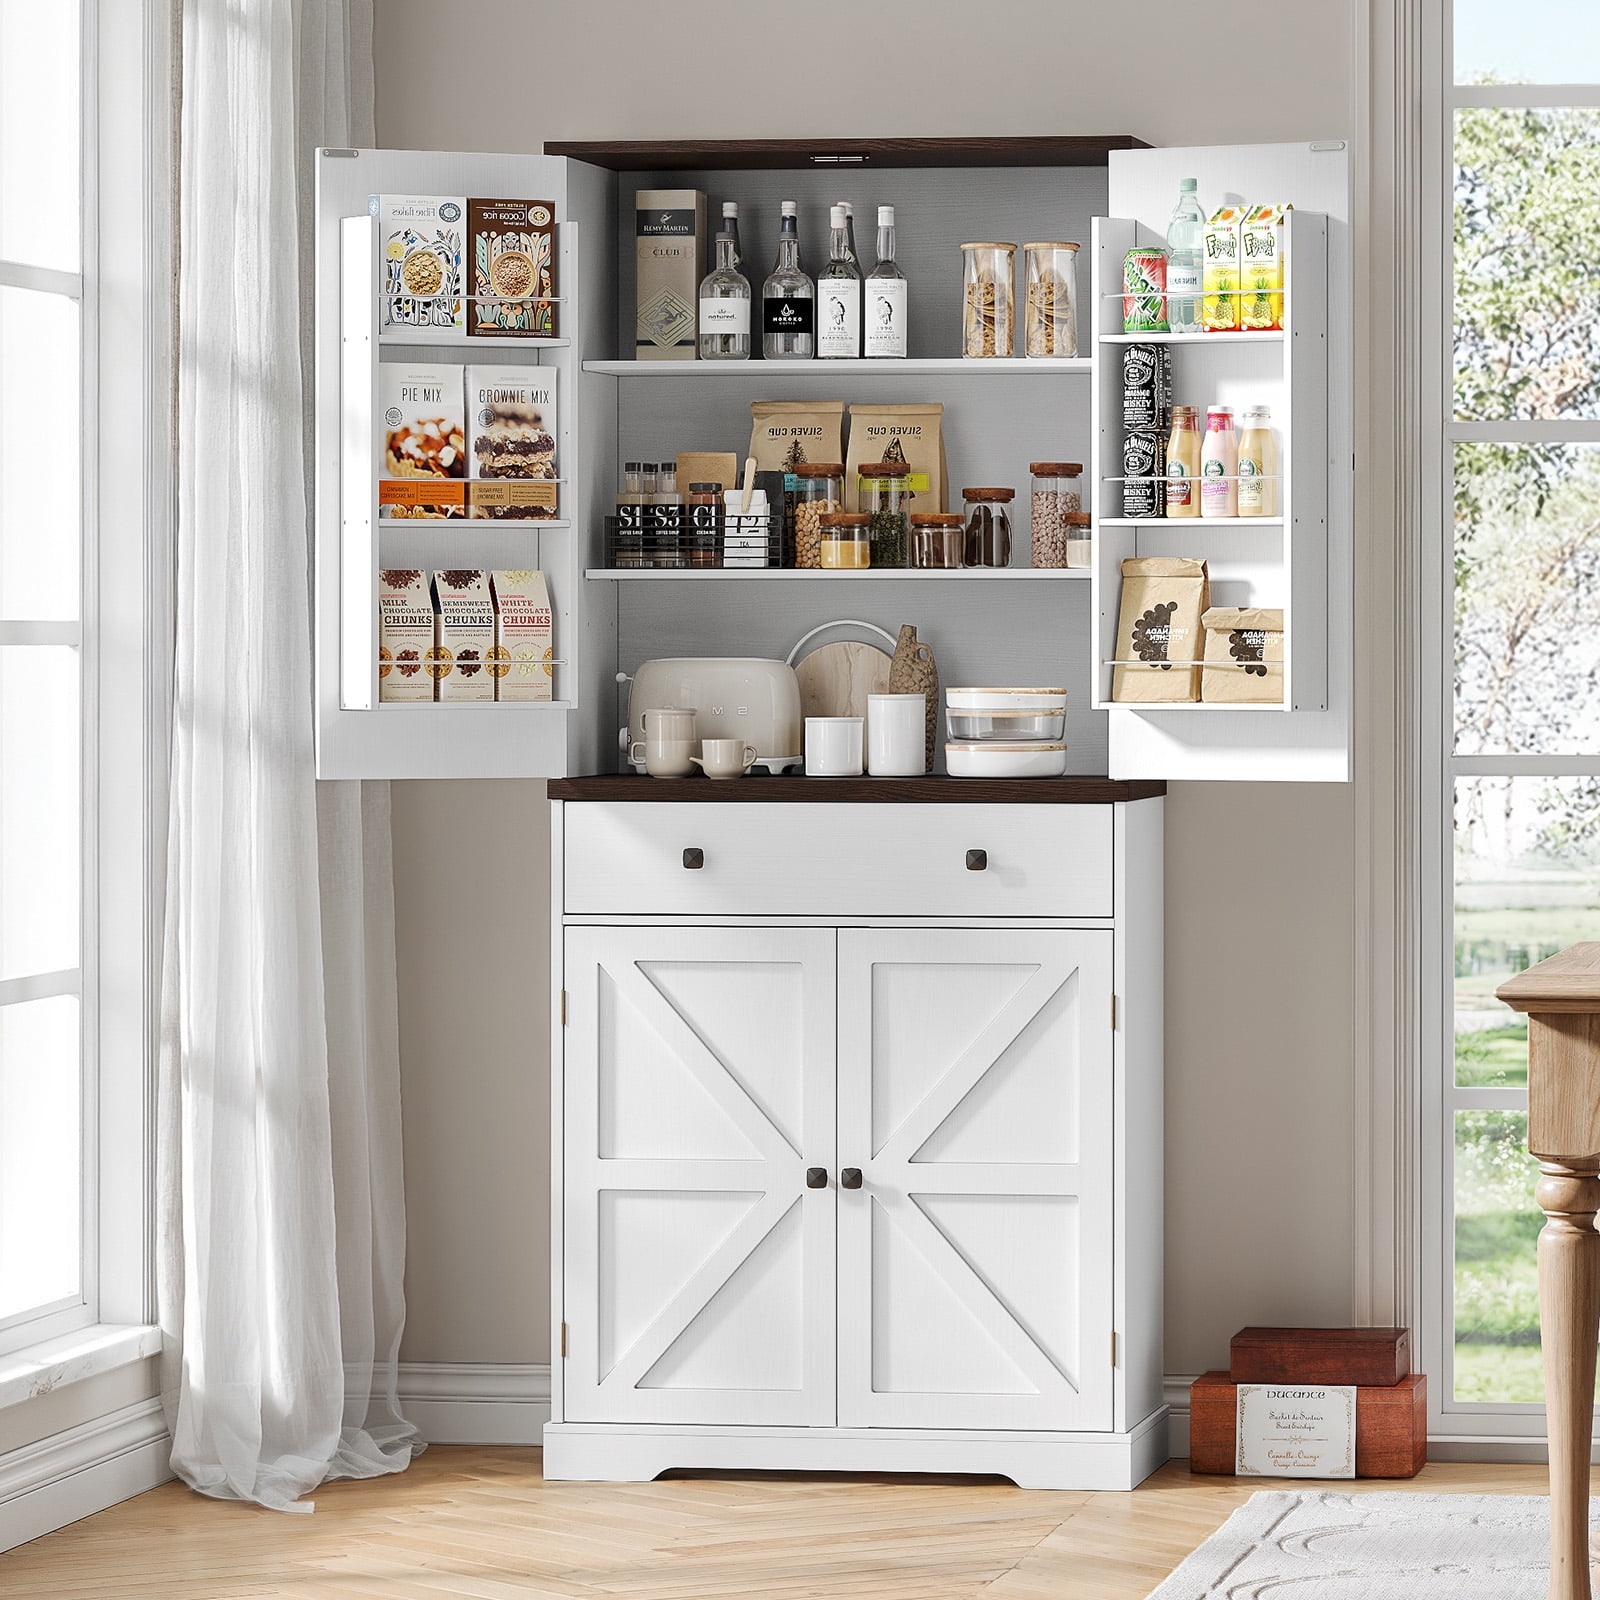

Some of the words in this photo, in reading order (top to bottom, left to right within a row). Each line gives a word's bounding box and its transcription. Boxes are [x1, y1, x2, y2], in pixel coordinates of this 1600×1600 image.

[653, 248, 680, 256] CLUB
[402, 388, 418, 402] PIE
[424, 388, 442, 402] MIX
[479, 389, 525, 403] BROWNIE
[532, 390, 549, 403] MIX
[619, 506, 640, 527] S1
[655, 506, 680, 527] S3
[693, 506, 716, 527] C1
[384, 616, 432, 624] CHUNKS
[445, 616, 492, 624] CHUNKS
[503, 616, 550, 624] CHUNKS
